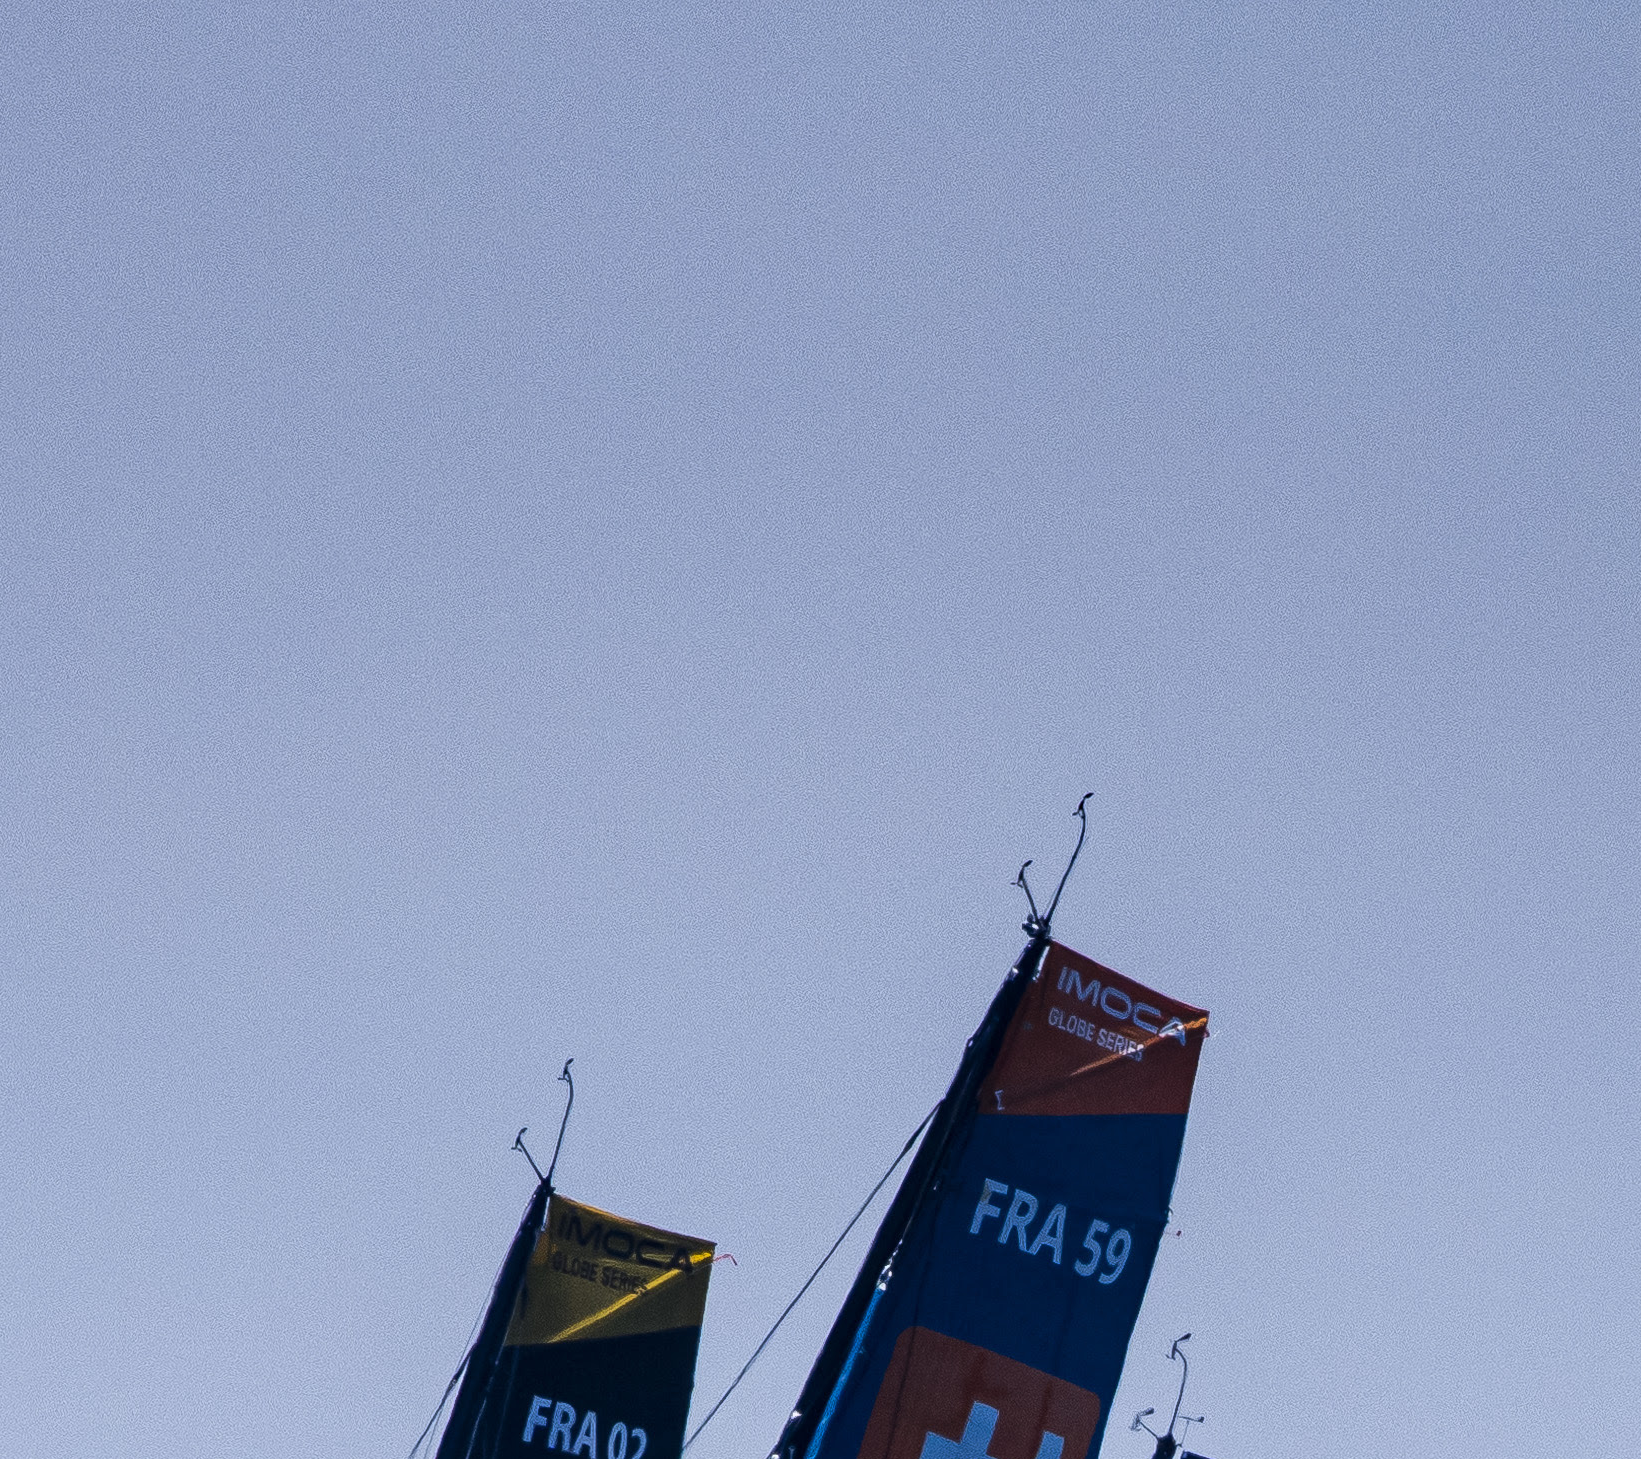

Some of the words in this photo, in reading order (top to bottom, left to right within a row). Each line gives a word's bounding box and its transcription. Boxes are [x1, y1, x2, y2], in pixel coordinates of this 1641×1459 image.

[1047, 1005, 1095, 1042] GLOBE
[1096, 1026, 1146, 1062] SERIES
[1057, 965, 1187, 1046] IMOCA
[558, 1210, 695, 1276] IMOCA
[969, 1177, 1068, 1265] FRA
[1073, 1218, 1133, 1285] 59
